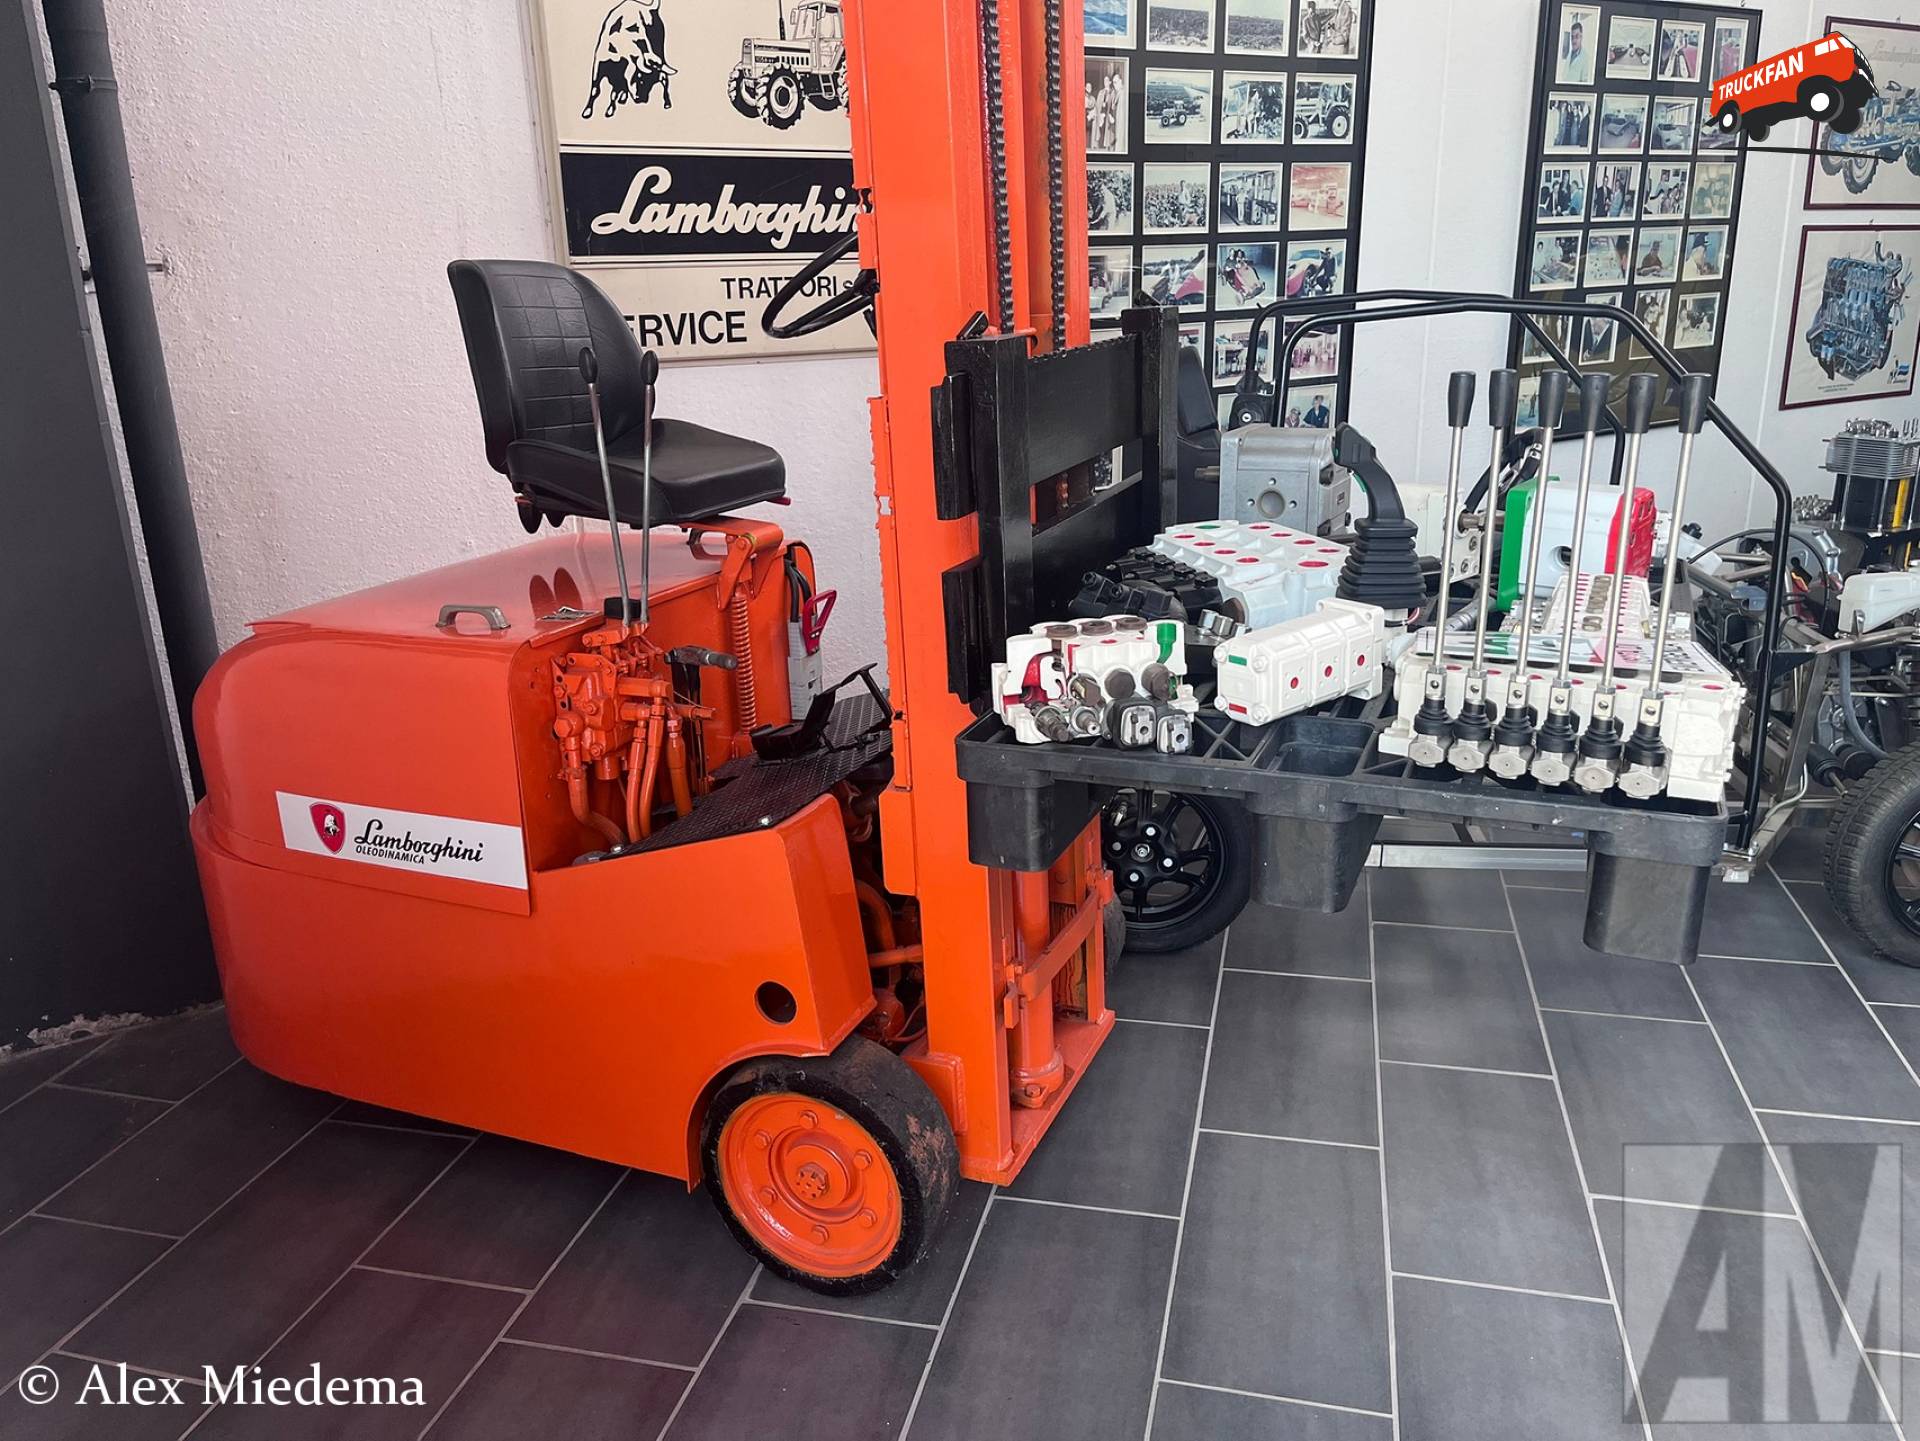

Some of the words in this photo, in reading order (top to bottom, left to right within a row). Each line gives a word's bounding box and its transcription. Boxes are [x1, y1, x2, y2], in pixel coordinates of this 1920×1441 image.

[623, 311, 747, 346] RVICE
[354, 818, 484, 863] Lamborghini
[355, 844, 425, 864] OLEODINAMICA
